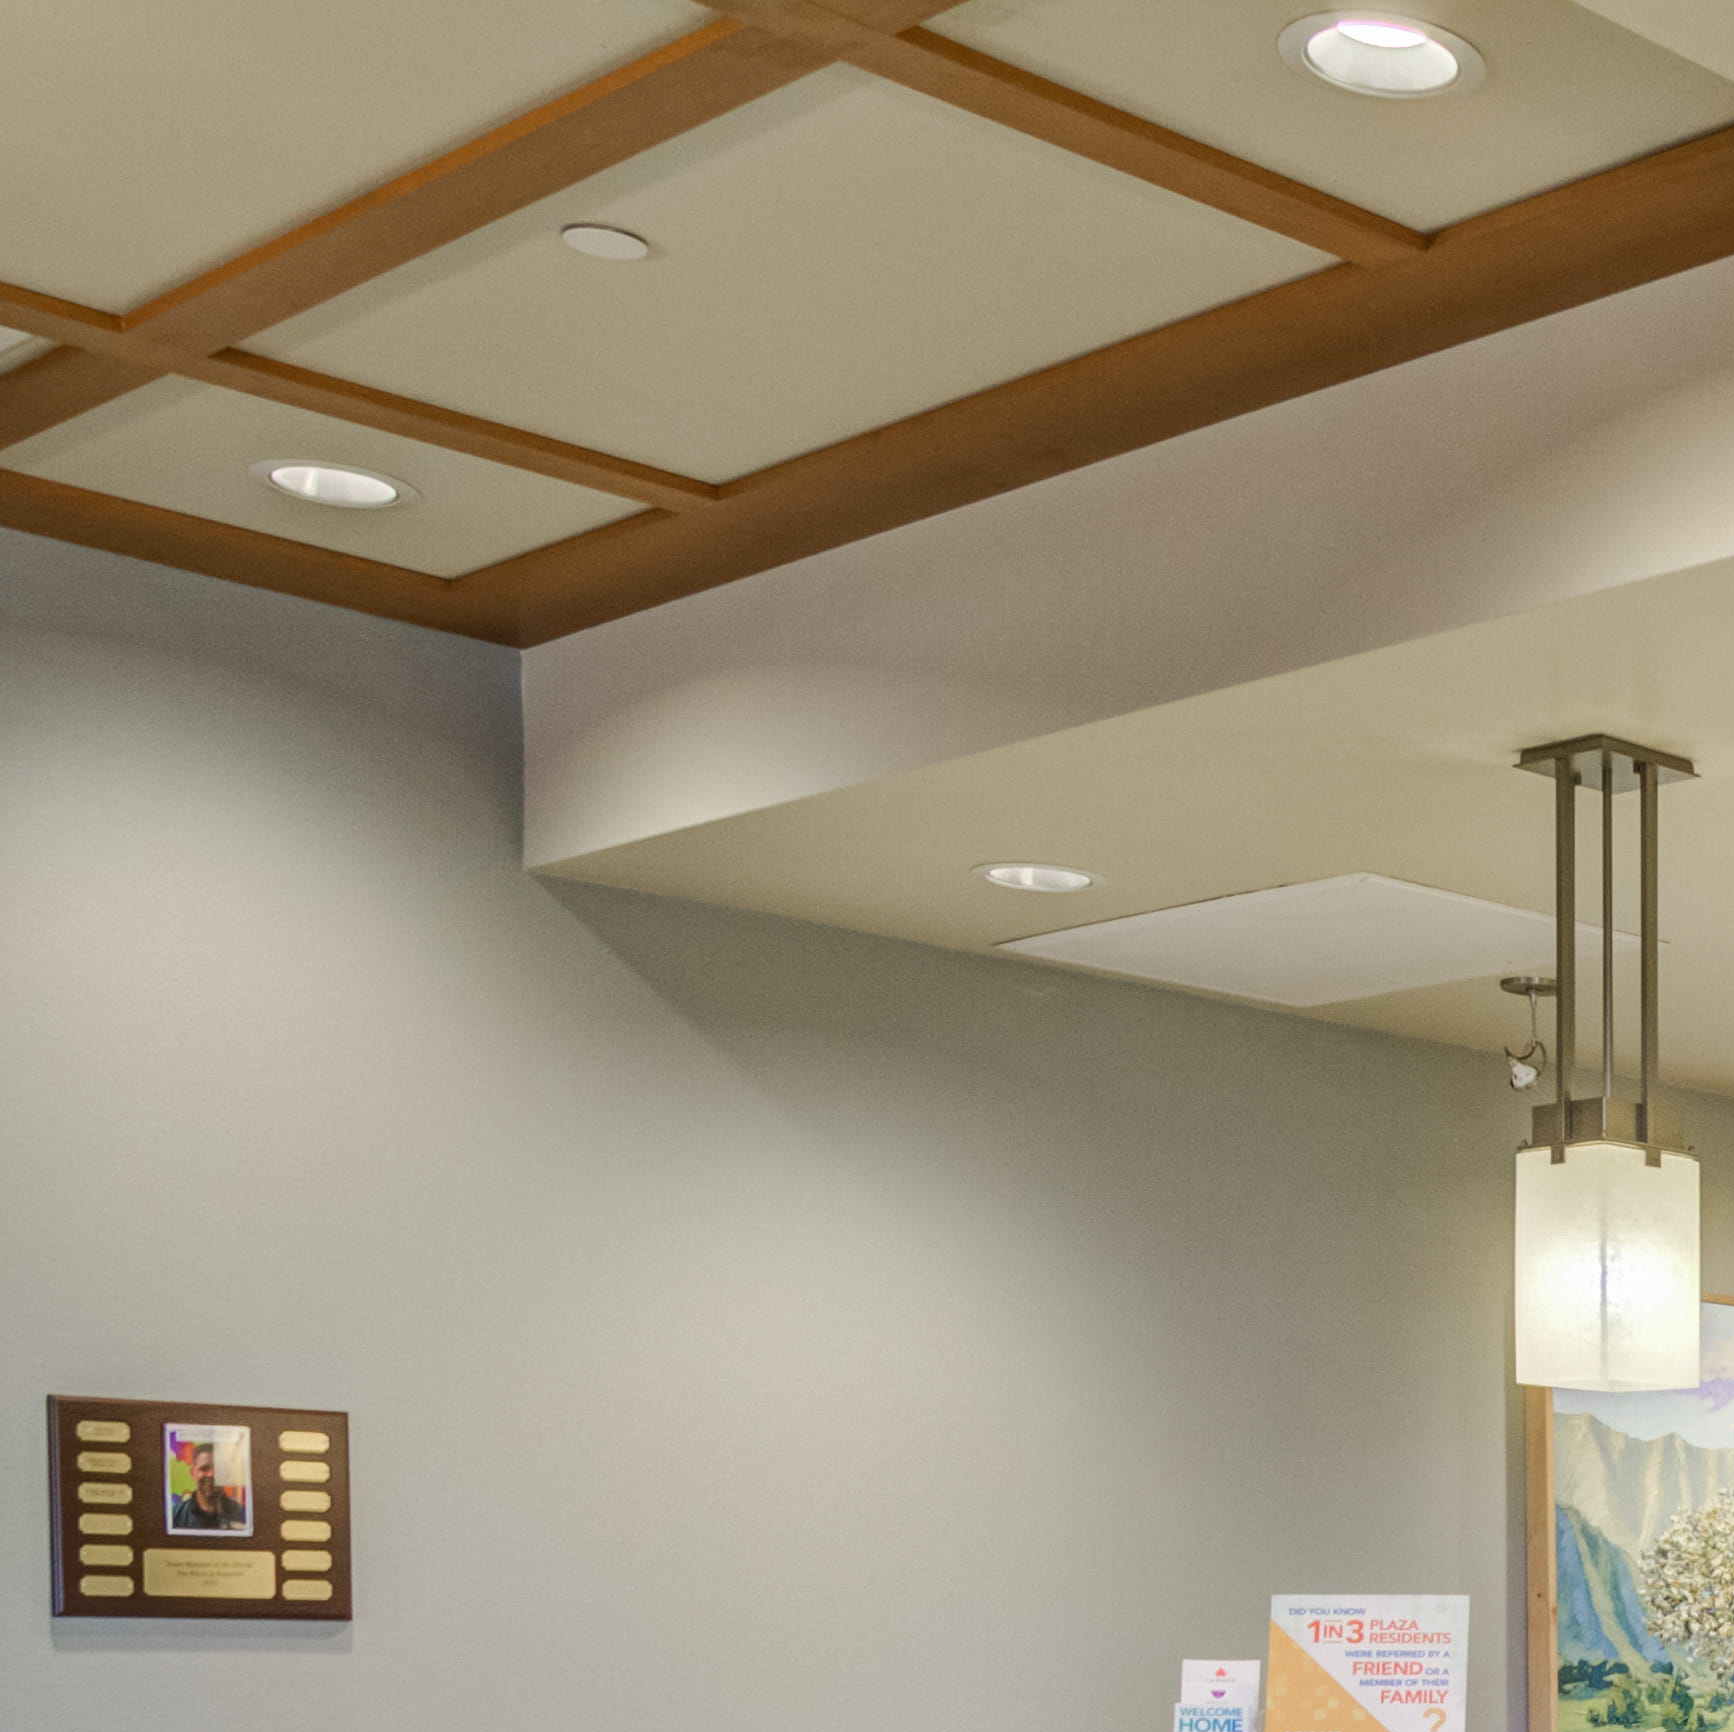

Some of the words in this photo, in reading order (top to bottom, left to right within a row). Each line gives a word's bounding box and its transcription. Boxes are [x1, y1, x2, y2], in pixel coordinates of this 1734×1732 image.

[1307, 1620, 1320, 1643] 1
[1323, 1624, 1343, 1638] IN
[1346, 1619, 1365, 1644] 3
[1370, 1619, 1418, 1630] PLAZA
[1369, 1633, 1452, 1644] RESIDENTS
[1352, 1661, 1423, 1676] FRIEND
[1425, 1668, 1440, 1676] OR
[1380, 1690, 1448, 1704] FAMILY
[1180, 1707, 1243, 1716] WELCOME
[1179, 1718, 1243, 1732] HOME
